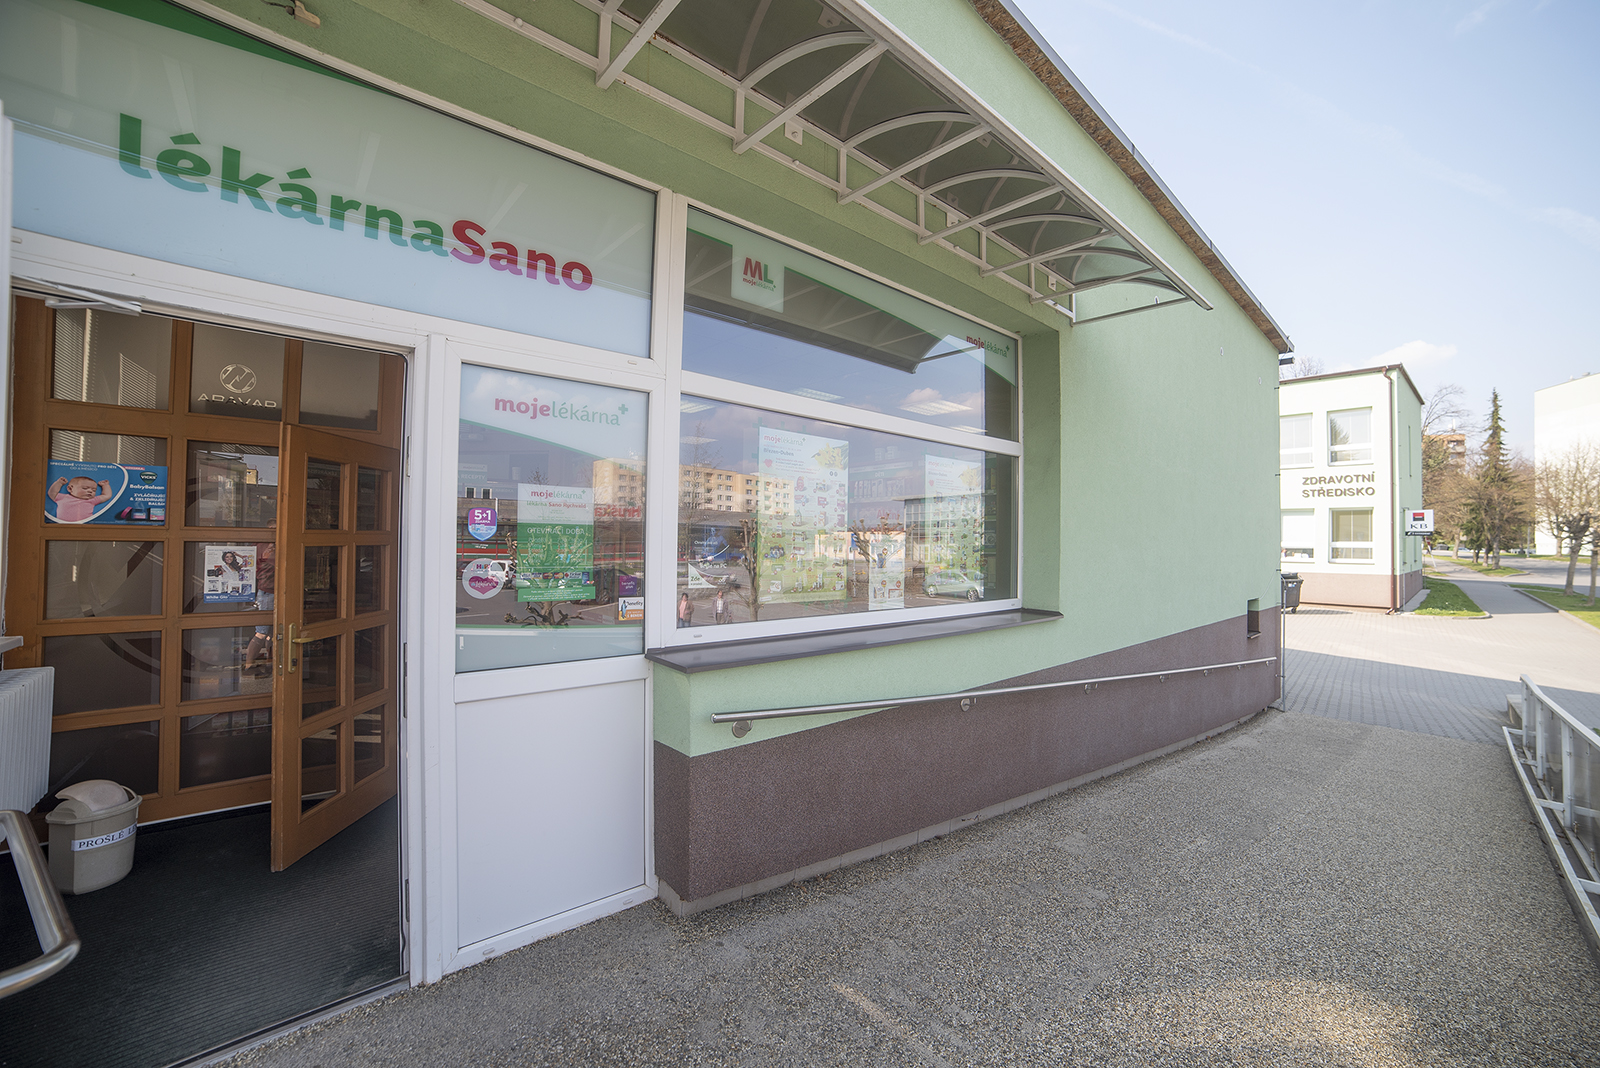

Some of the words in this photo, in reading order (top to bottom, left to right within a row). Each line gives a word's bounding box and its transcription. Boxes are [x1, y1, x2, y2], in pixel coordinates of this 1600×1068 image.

[119, 112, 593, 291] lékárnaSano
[743, 257, 774, 285] ML
[494, 397, 621, 426] mojelékárna
[1302, 471, 1375, 485] ZDRAVOTNÍ
[530, 490, 583, 499] mojelékárna
[1302, 487, 1376, 498] STŘEDISKO
[474, 509, 491, 521] 5+1
[78, 830, 125, 849] PROŠLÉ
